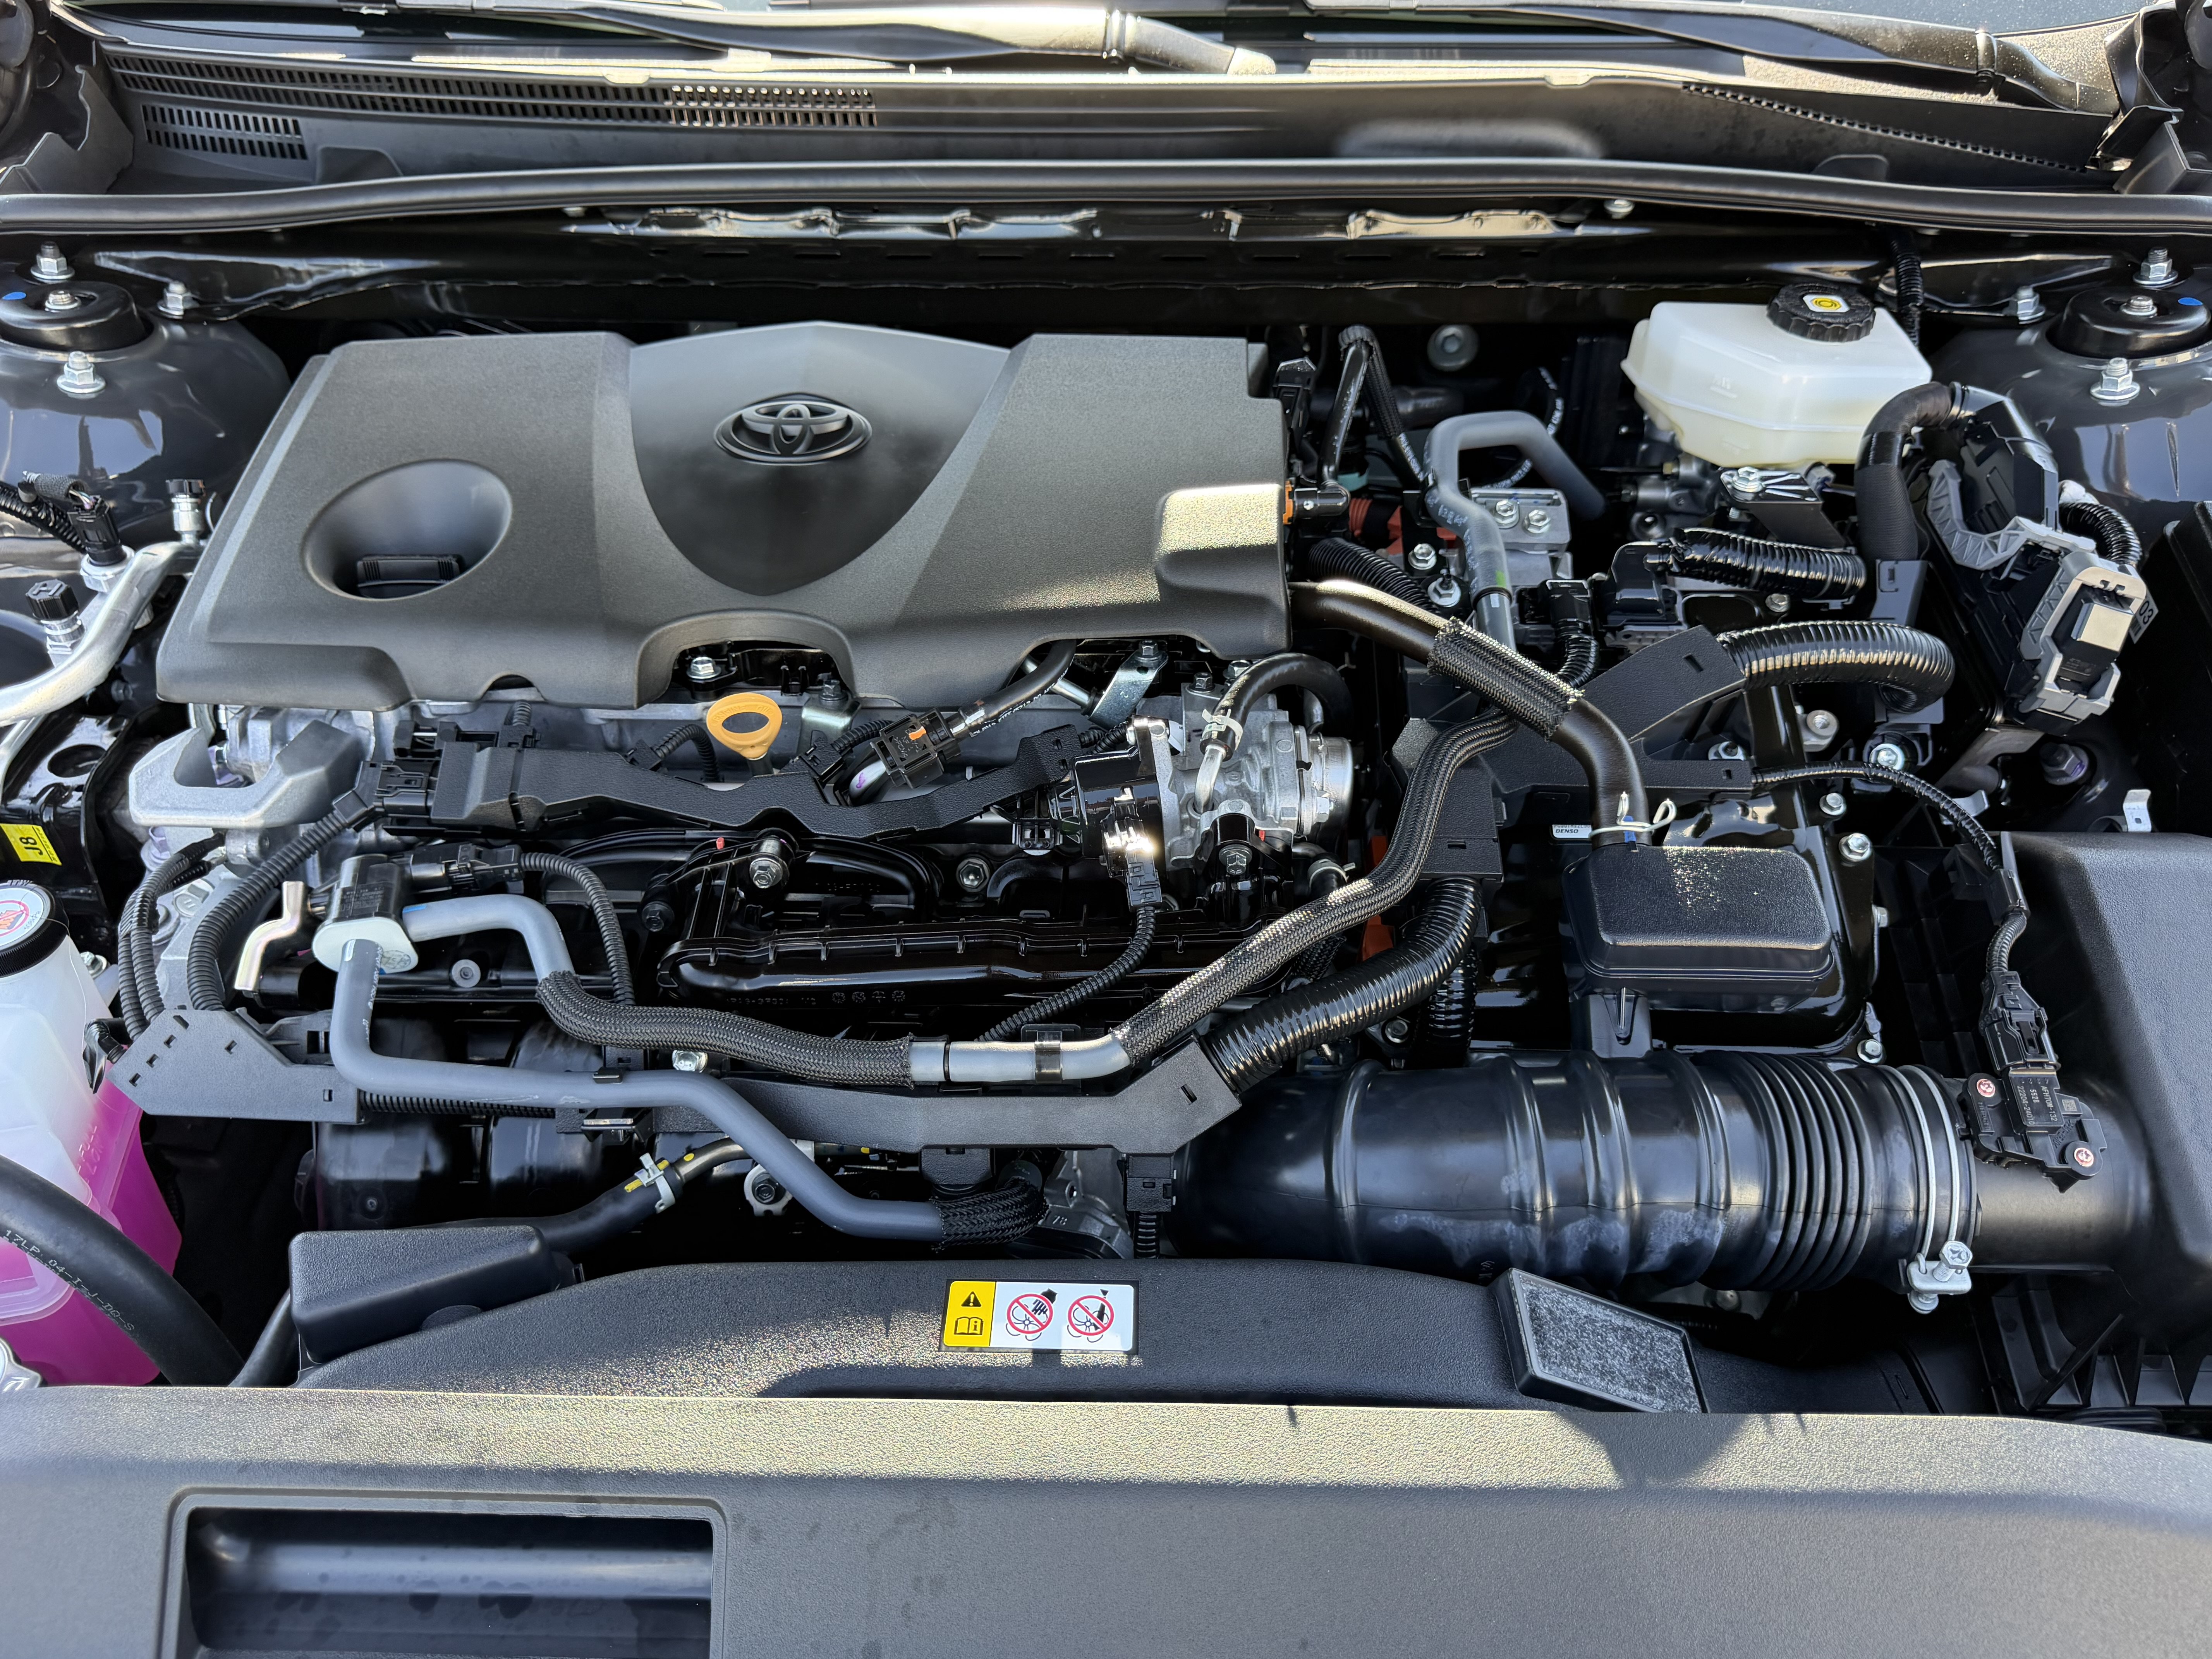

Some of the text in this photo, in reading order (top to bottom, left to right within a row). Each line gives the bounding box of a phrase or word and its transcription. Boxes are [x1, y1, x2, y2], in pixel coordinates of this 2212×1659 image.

[2139, 600, 2154, 625] 03
[19, 836, 43, 855] J8
[2017, 1085, 2035, 1125] 22204-24010
[2030, 1089, 2040, 1103] 5528
[2041, 1085, 2058, 1122] AFH70M-132
[5, 1230, 40, 1254] 17LP
